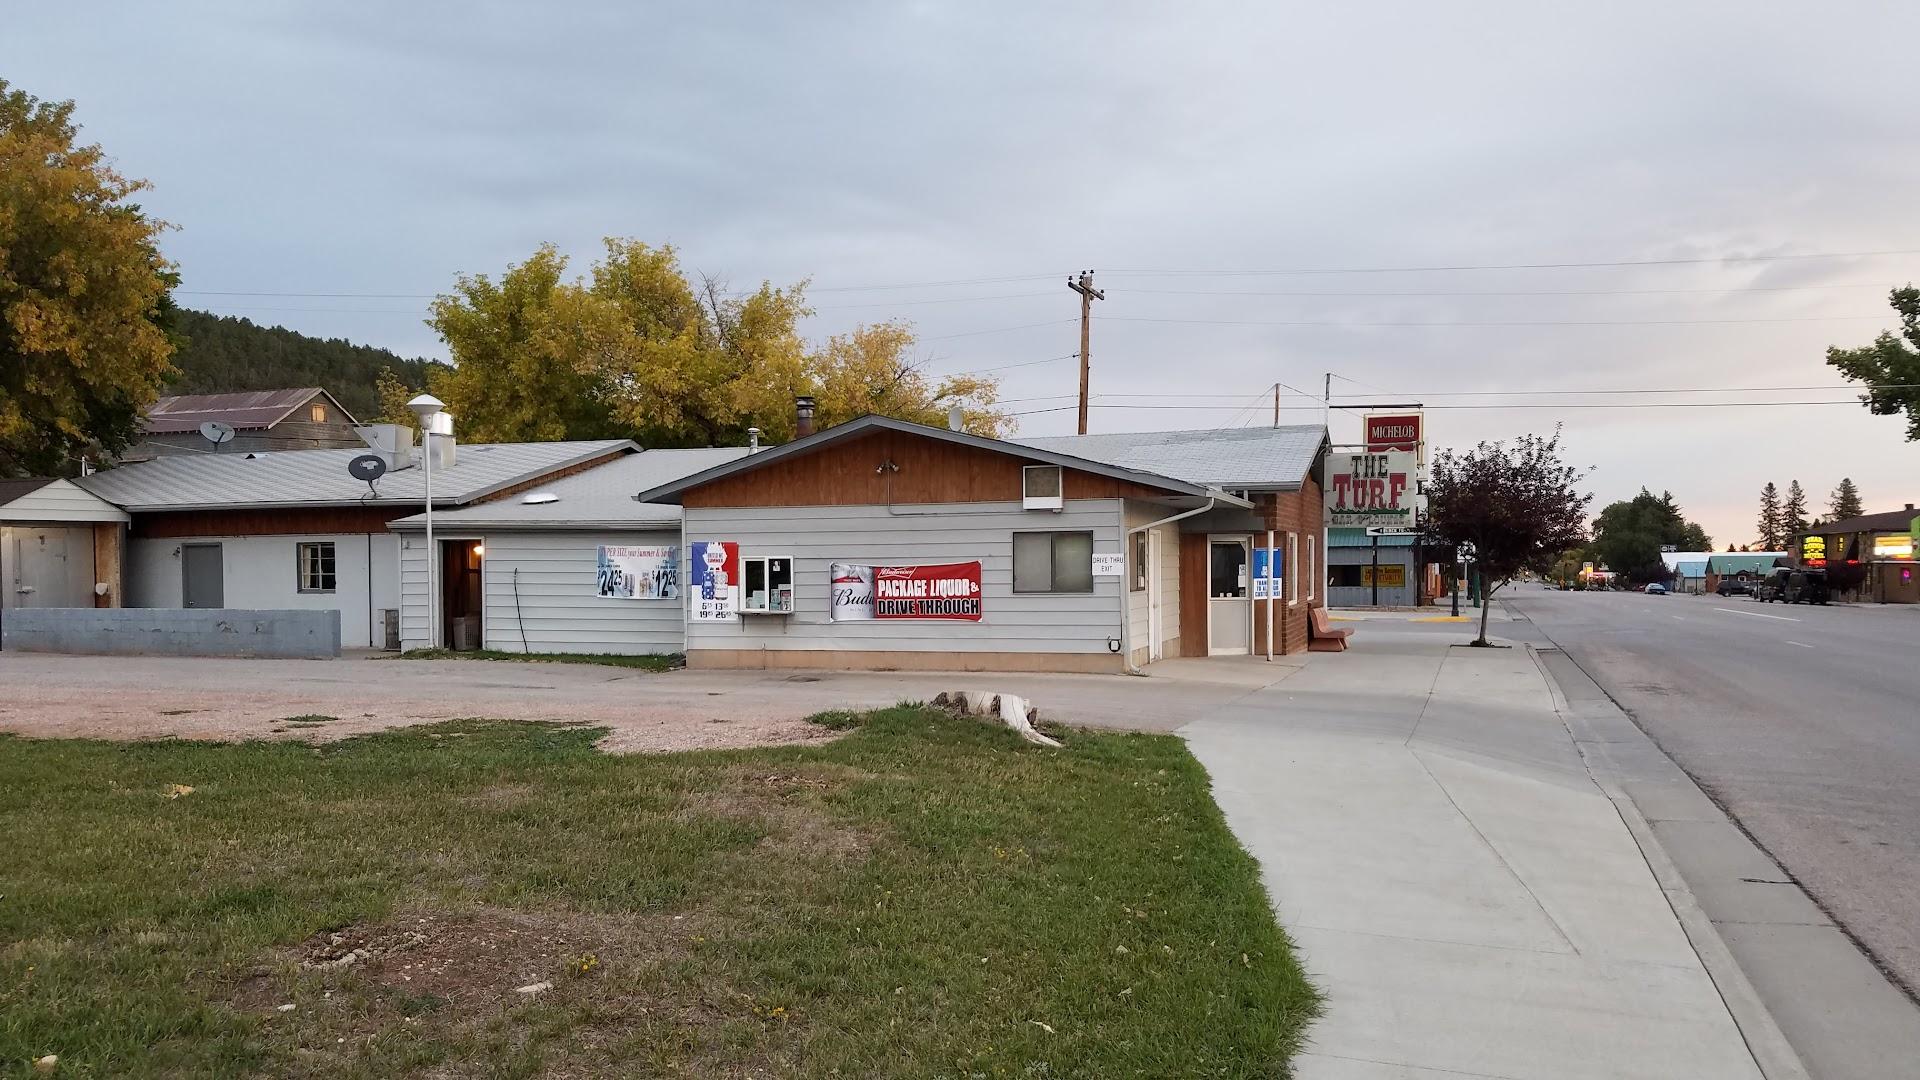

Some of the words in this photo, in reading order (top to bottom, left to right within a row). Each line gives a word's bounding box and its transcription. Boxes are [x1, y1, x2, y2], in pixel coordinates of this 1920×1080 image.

[1371, 425, 1415, 439] MICHELOB
[1351, 455, 1388, 479] THE
[1333, 473, 1407, 510] TURF
[1093, 556, 1108, 564] DRIVE
[1110, 556, 1124, 564] THRU
[878, 579, 927, 598] PACKAGE
[878, 600, 915, 615] DRIVE
[918, 598, 979, 615] THROUGH
